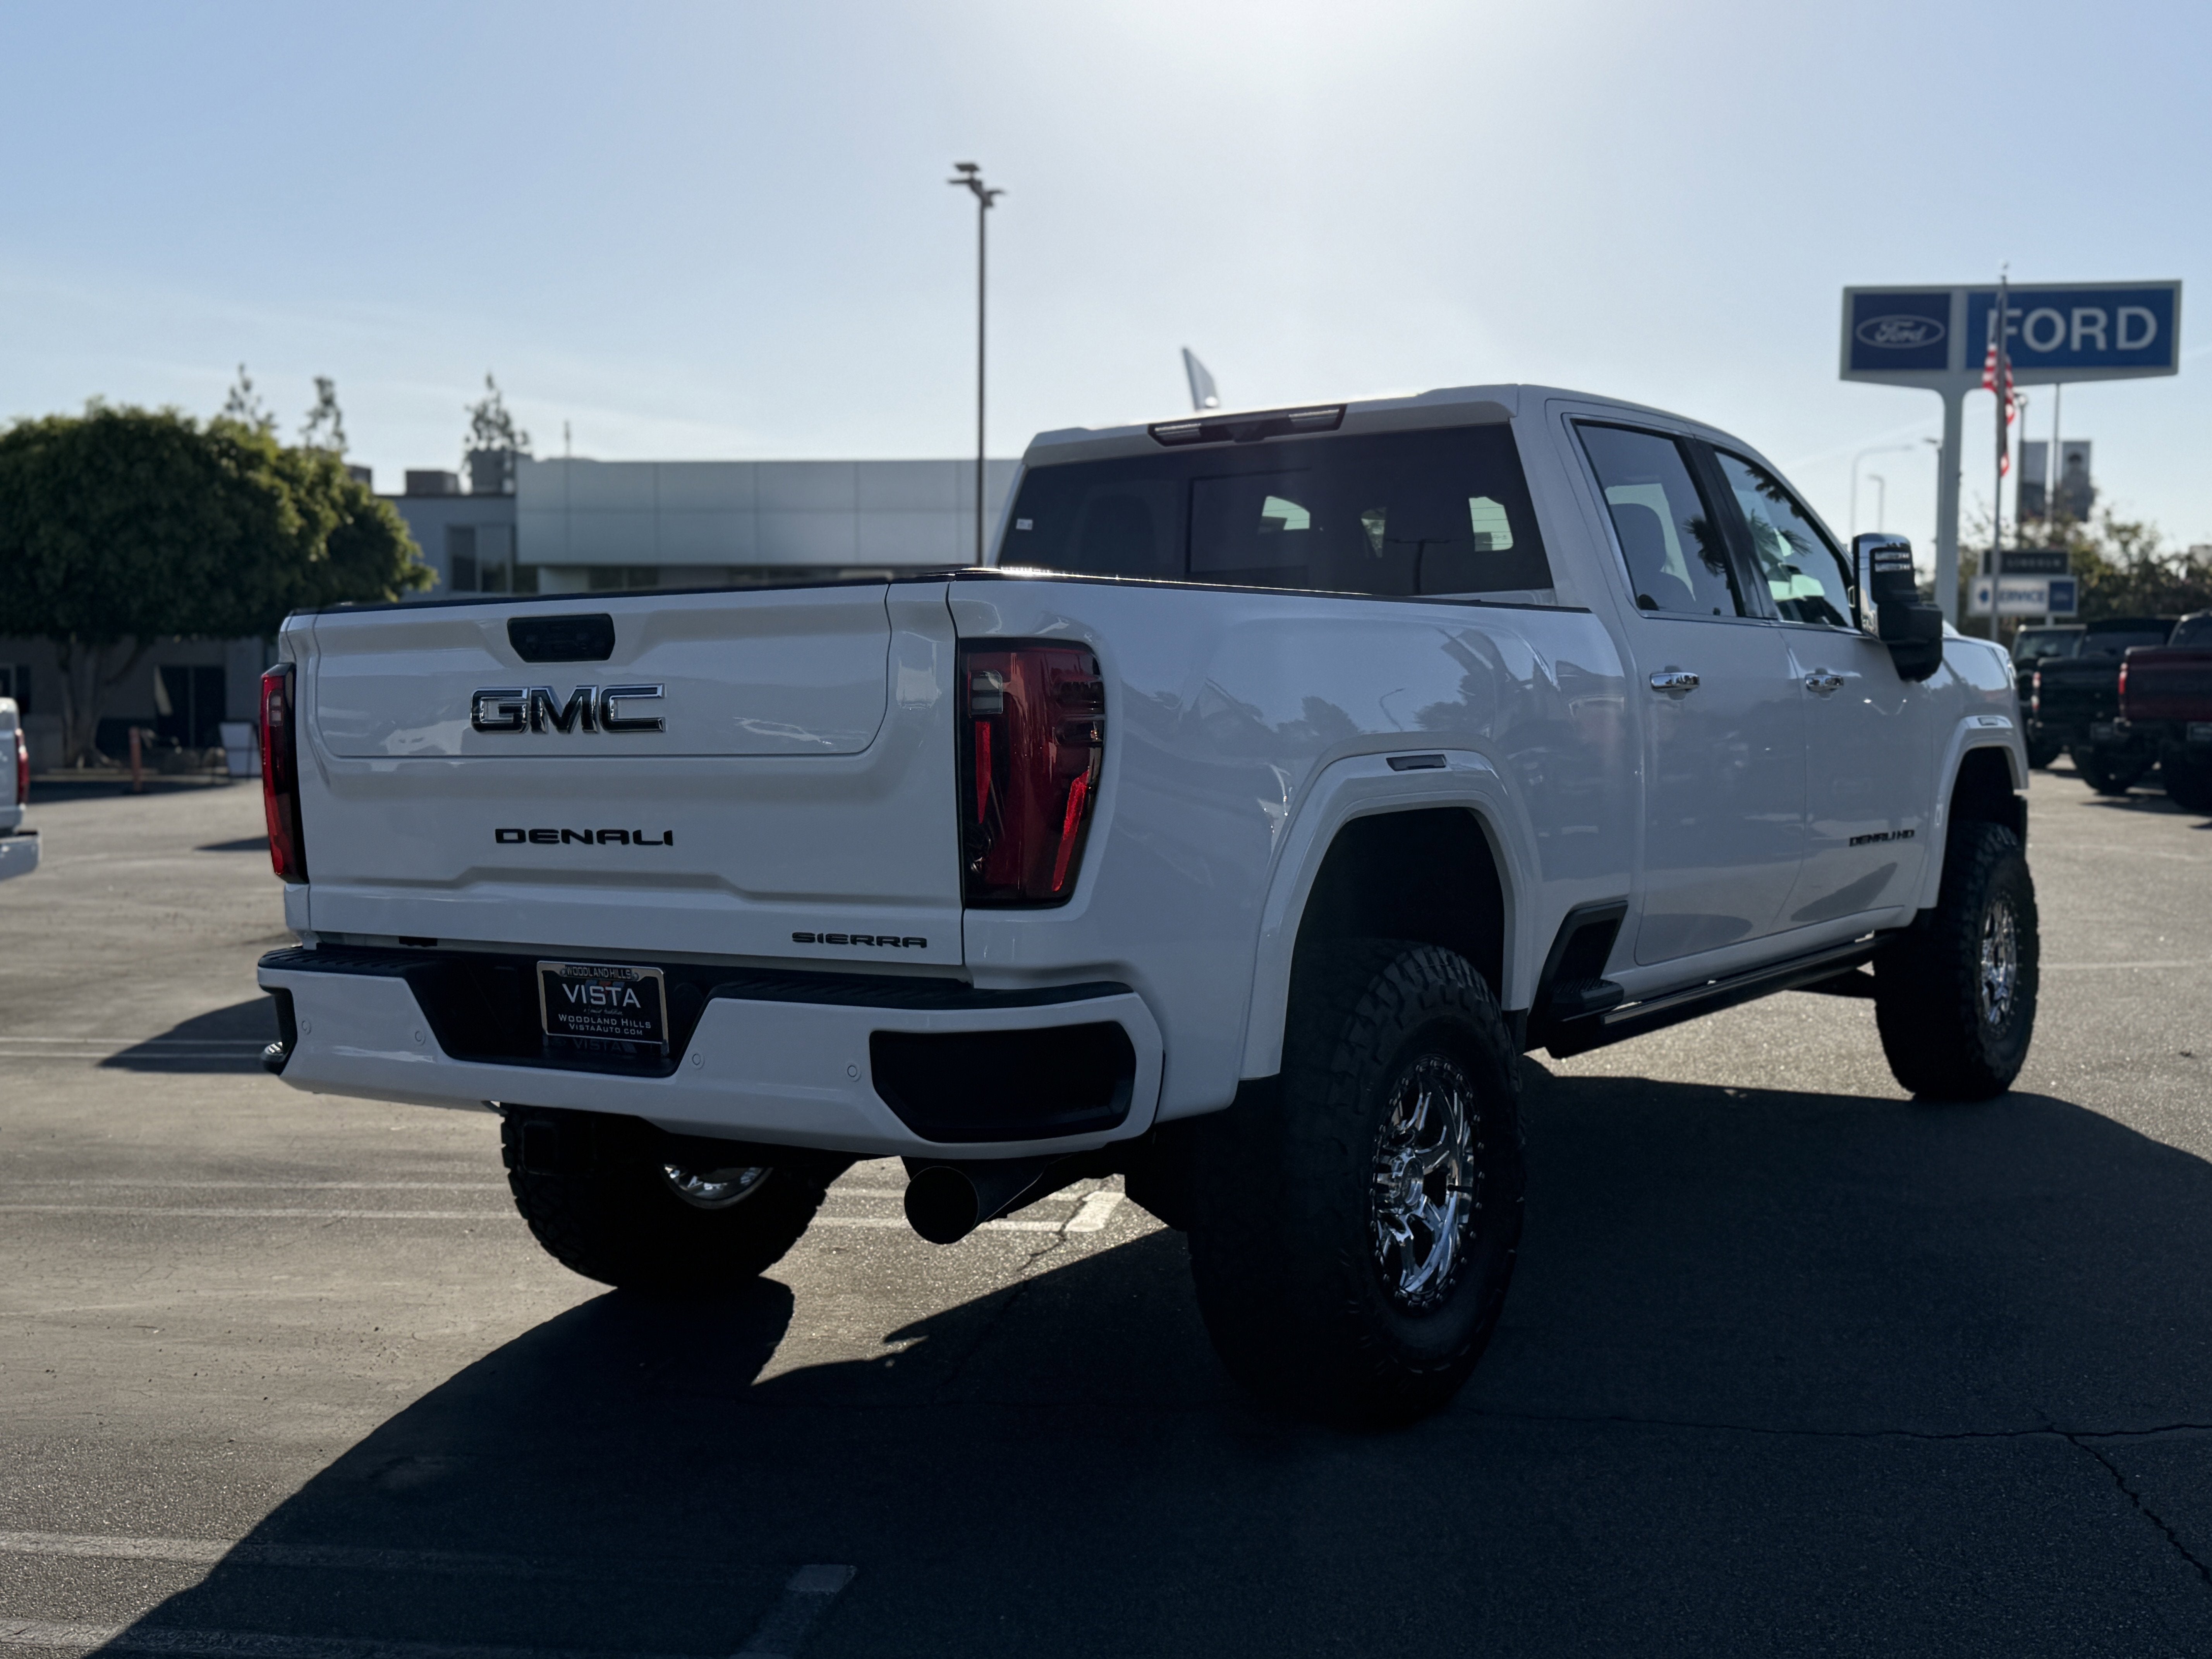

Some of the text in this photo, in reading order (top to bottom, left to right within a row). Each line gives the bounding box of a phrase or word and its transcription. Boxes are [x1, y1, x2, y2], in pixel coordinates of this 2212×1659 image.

[1874, 320, 1928, 343] Ford
[1987, 306, 2158, 352] FORD
[471, 683, 666, 733] GMC
[495, 829, 673, 846] DENALI
[1849, 830, 1915, 847] DENALI HD
[792, 932, 927, 948] SIERRA
[567, 966, 632, 980] WOODLAND HILLS
[562, 984, 641, 1008] VISTA
[558, 1014, 651, 1029] WOODLAND HILLS
